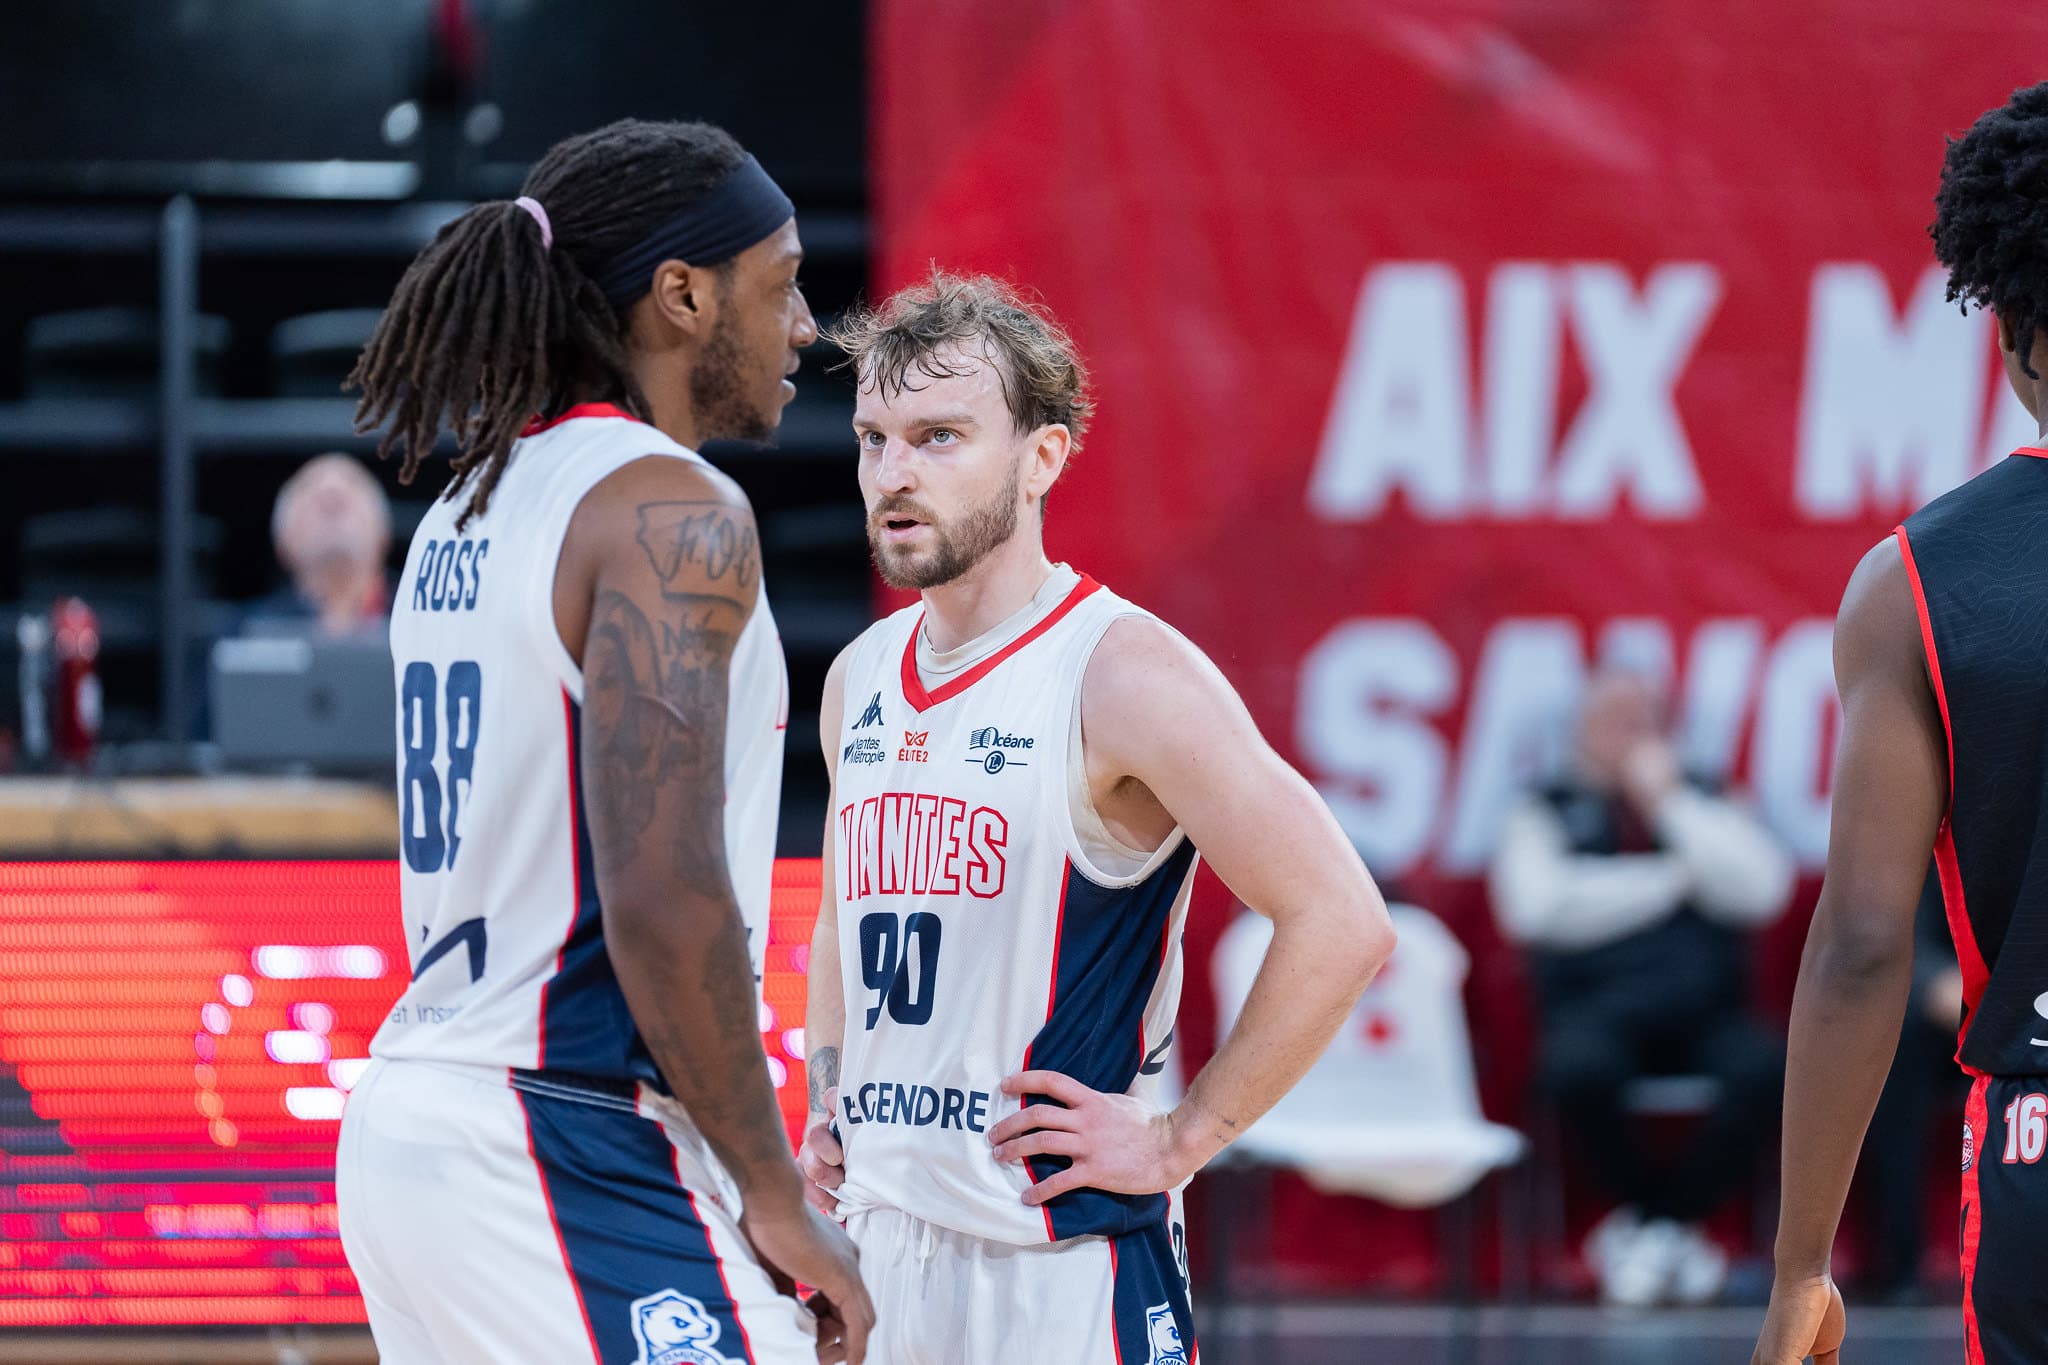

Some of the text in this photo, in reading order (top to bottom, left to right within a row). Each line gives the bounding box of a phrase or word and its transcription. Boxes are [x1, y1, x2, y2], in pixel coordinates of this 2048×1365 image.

[1307, 261, 1720, 520] AIX
[413, 538, 489, 612] ROSS
[402, 661, 481, 873] 88
[859, 912, 942, 1030] 90
[843, 1083, 989, 1133] LGENDRE
[2002, 1093, 2048, 1165] 16
